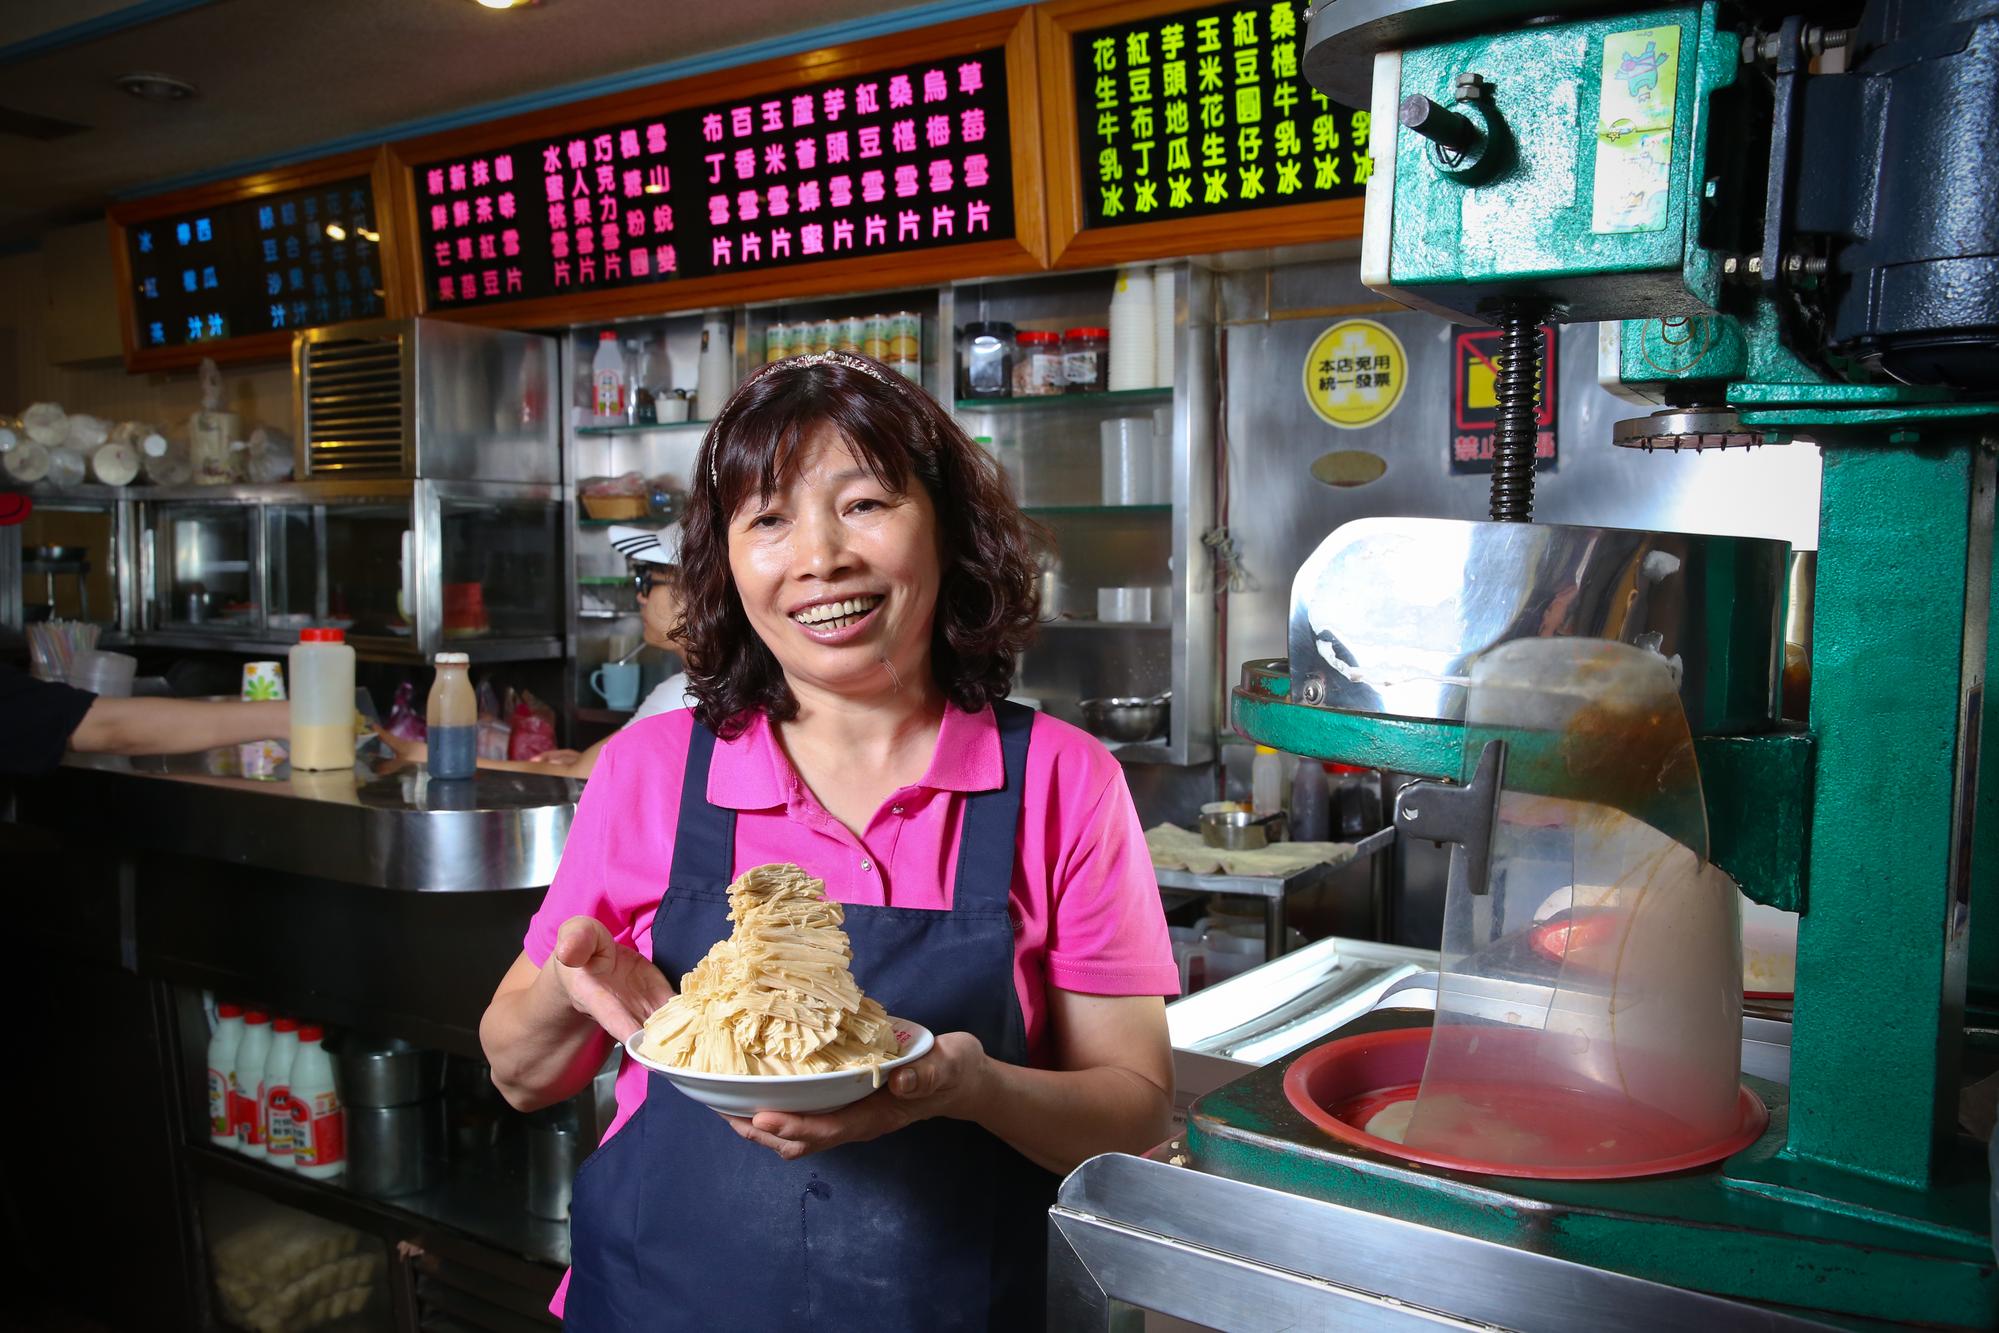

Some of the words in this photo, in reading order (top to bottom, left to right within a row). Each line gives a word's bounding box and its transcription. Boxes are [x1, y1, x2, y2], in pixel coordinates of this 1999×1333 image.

[761, 101, 792, 259] 玉米雪片
[823, 88, 854, 250] 芋頭雪片
[855, 83, 887, 246] 紅豆雪片
[889, 75, 920, 242] 桑椹雪片
[958, 62, 991, 233] 草莓雪片
[1092, 37, 1124, 216] 花生牛乳冰
[1126, 32, 1158, 212] 紅豆布丁冰
[1160, 23, 1193, 208] 芋頭地瓜冰
[1196, 16, 1228, 204] 玉米花生冰
[1232, 11, 1264, 200] 紅豆圓仔冰
[1269, 2, 1302, 194] 桑椹牛乳冰
[593, 134, 622, 280] 巧克力雪片
[702, 113, 732, 266] 布丁雪片
[731, 106, 761, 262] 百香雪片
